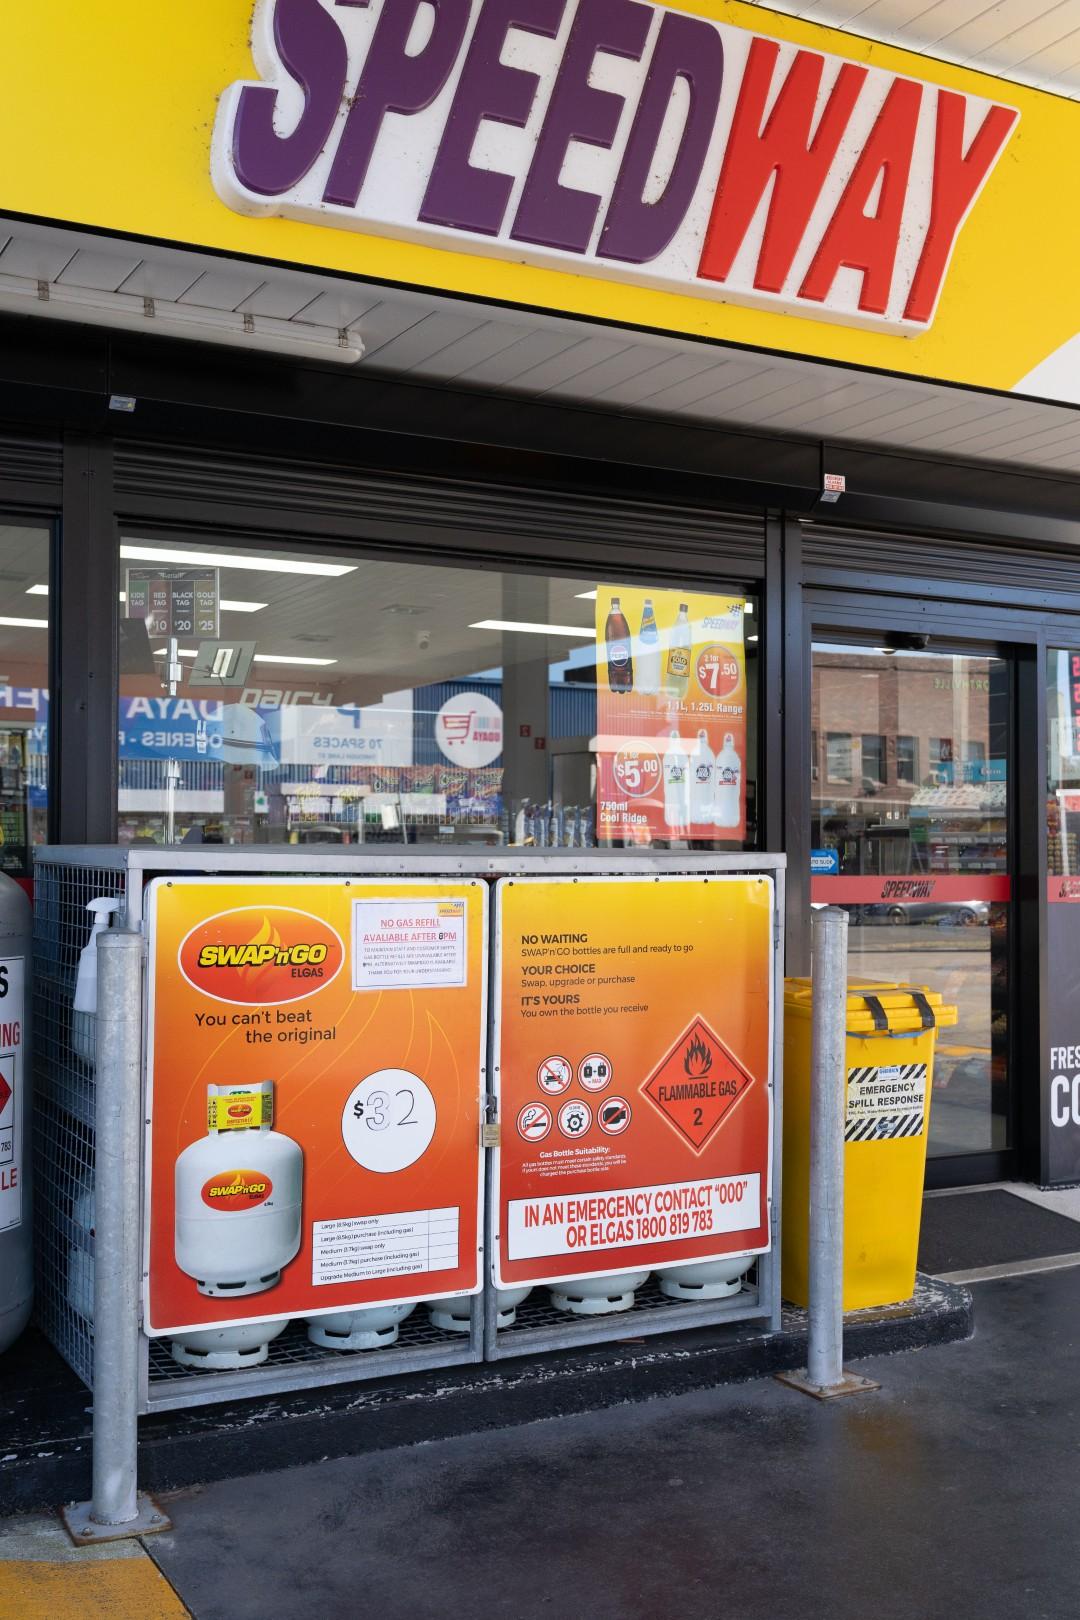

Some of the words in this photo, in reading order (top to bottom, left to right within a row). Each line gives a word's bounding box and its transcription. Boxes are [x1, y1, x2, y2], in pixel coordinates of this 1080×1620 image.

[232, 0, 1019, 322] SPEEDWAY
[174, 620, 191, 630] $20
[198, 620, 214, 630] $25
[691, 702, 714, 713] 1.25L
[717, 704, 743, 715] Range
[601, 801, 628, 811] 750ml
[600, 812, 620, 823] Cool
[622, 812, 648, 825] Ridge
[881, 880, 936, 898] SPEEDWAY
[380, 919, 394, 928] NO
[396, 919, 413, 927] GAS
[415, 918, 440, 927] REFILL
[411, 932, 437, 941] AFTER
[521, 935, 539, 945] NO
[541, 933, 588, 944] WAITING
[198, 943, 328, 968] SWAP'n'GO
[572, 946, 601, 955] bottles
[603, 946, 616, 954] are
[617, 945, 631, 953] full
[632, 944, 648, 953] and
[650, 944, 672, 954] ready
[683, 944, 694, 953] go
[291, 967, 324, 978] ELGAS
[521, 965, 553, 975] YOUR
[554, 963, 596, 974] CHOICE
[549, 977, 585, 987] upgrade
[586, 977, 596, 985] or
[597, 975, 636, 986] purchase
[521, 995, 541, 1006] IT'S
[542, 994, 580, 1005] YOURS
[194, 1013, 227, 1026] You
[231, 1011, 272, 1025] can't
[276, 1009, 313, 1024] beat
[520, 1009, 537, 1018] You
[539, 1009, 558, 1017] own
[560, 1007, 574, 1016] the
[576, 1006, 601, 1015] bottle
[603, 1007, 618, 1016] you
[620, 1004, 649, 1012] receive
[0, 1021, 20, 1048] NG
[245, 1029, 273, 1043] the
[277, 1027, 336, 1044] original
[658, 1081, 716, 1102] FLAMMABLE
[718, 1080, 737, 1096] GAS
[859, 1082, 916, 1096] EMERGENCY
[848, 1098, 875, 1109] SPILL
[877, 1094, 924, 1106] RESPONSE
[693, 1107, 703, 1126] 2
[553, 1149, 574, 1157] Bottle
[524, 1203, 540, 1227] IN
[542, 1201, 564, 1225] AN
[567, 1193, 653, 1223] EMERGENCY
[654, 1185, 713, 1213] CONTACT
[377, 1228, 402, 1236] (including
[566, 1225, 587, 1248] OR
[590, 1219, 634, 1245] ELGAS
[636, 1215, 667, 1240] 1800
[669, 1212, 690, 1235] 819
[692, 1208, 713, 1232] 783
[359, 1256, 383, 1264] purchase
[383, 1252, 408, 1260] (including
[321, 1273, 343, 1281] Upgrade
[343, 1270, 365, 1278] Medium
[386, 1265, 411, 1274] (including
